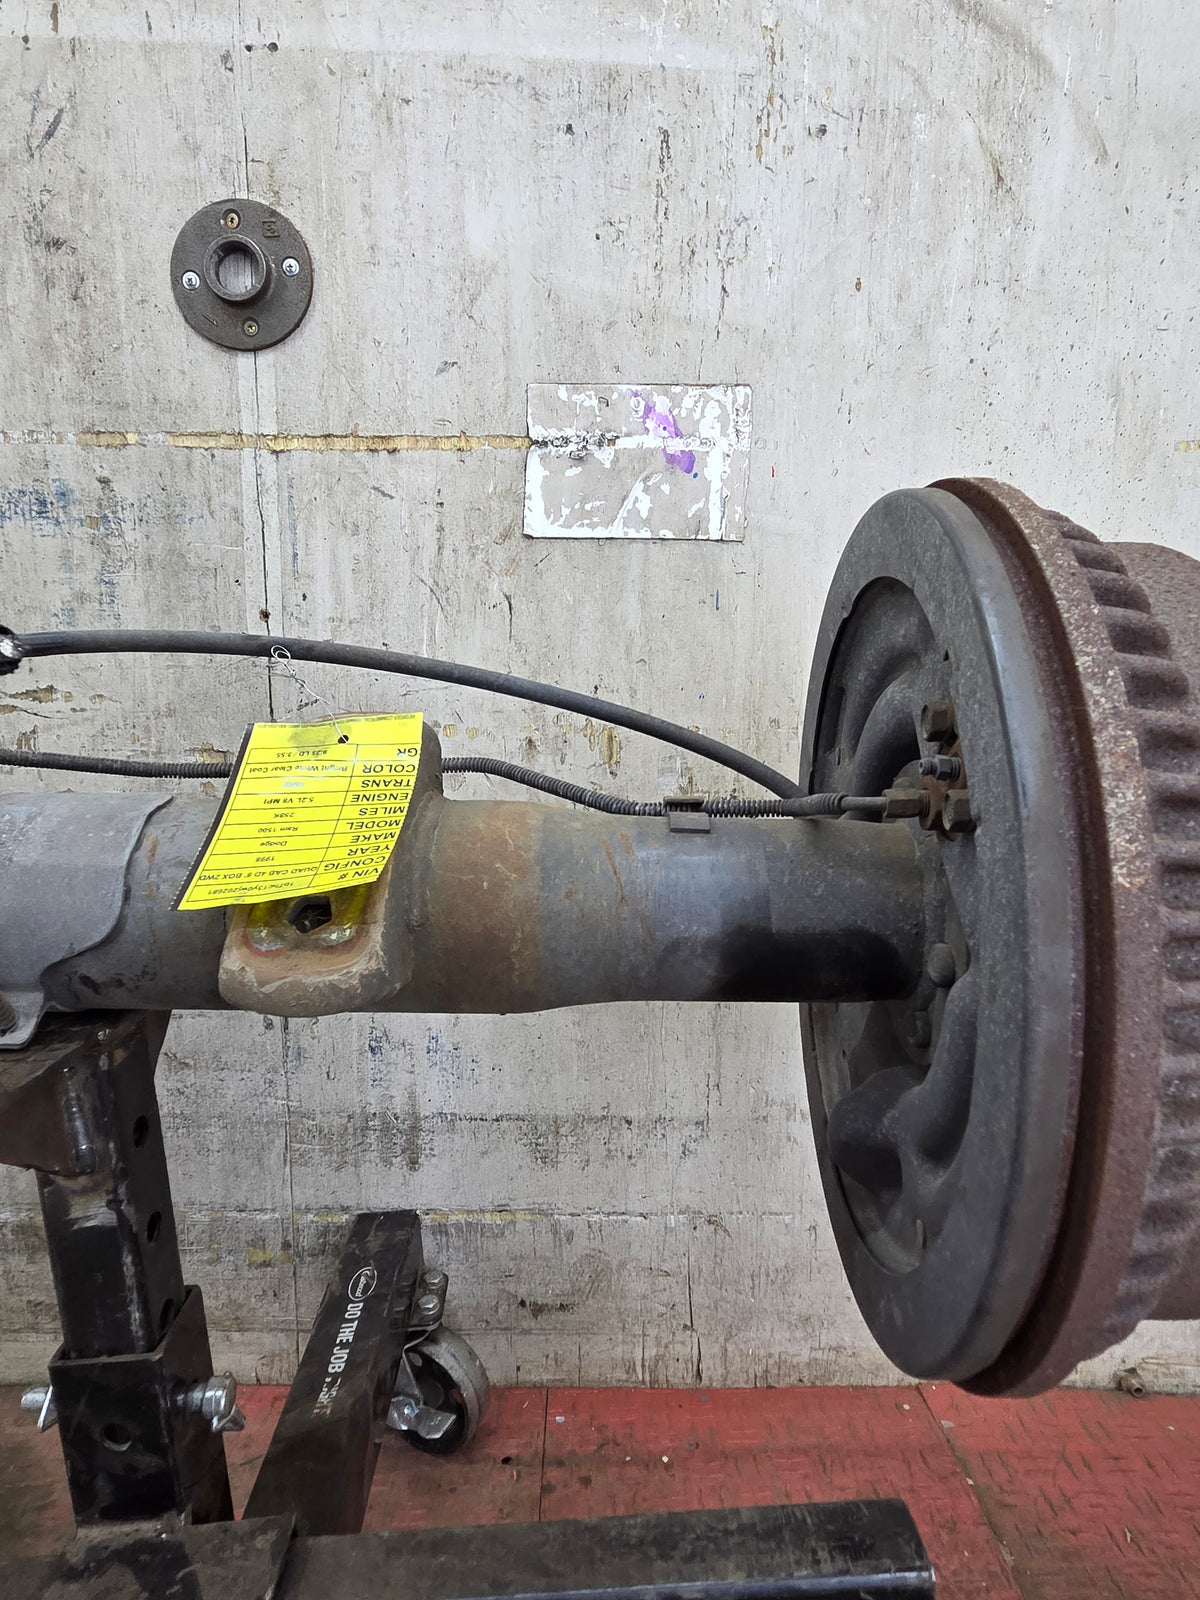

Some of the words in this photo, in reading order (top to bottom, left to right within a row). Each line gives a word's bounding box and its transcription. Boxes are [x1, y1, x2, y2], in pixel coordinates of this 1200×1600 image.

[396, 747, 418, 758] GR
[249, 766, 269, 774] Coat
[321, 764, 348, 772] Bright
[362, 764, 416, 774] COLOR
[361, 779, 412, 788] TRANS
[350, 792, 409, 803] ENGINE
[359, 806, 406, 816] MILES
[346, 818, 401, 830] MODEL
[349, 831, 397, 844] MAKE
[347, 843, 391, 856] YEAR
[323, 855, 386, 871] CONFIG
[222, 872, 243, 880] BOX
[290, 866, 318, 875] QUAD
[352, 867, 379, 878] VIN
[337, 872, 349, 881] #
[345, 1302, 364, 1319] DO
[336, 1320, 358, 1344] THE
[328, 1346, 350, 1374] JOB
